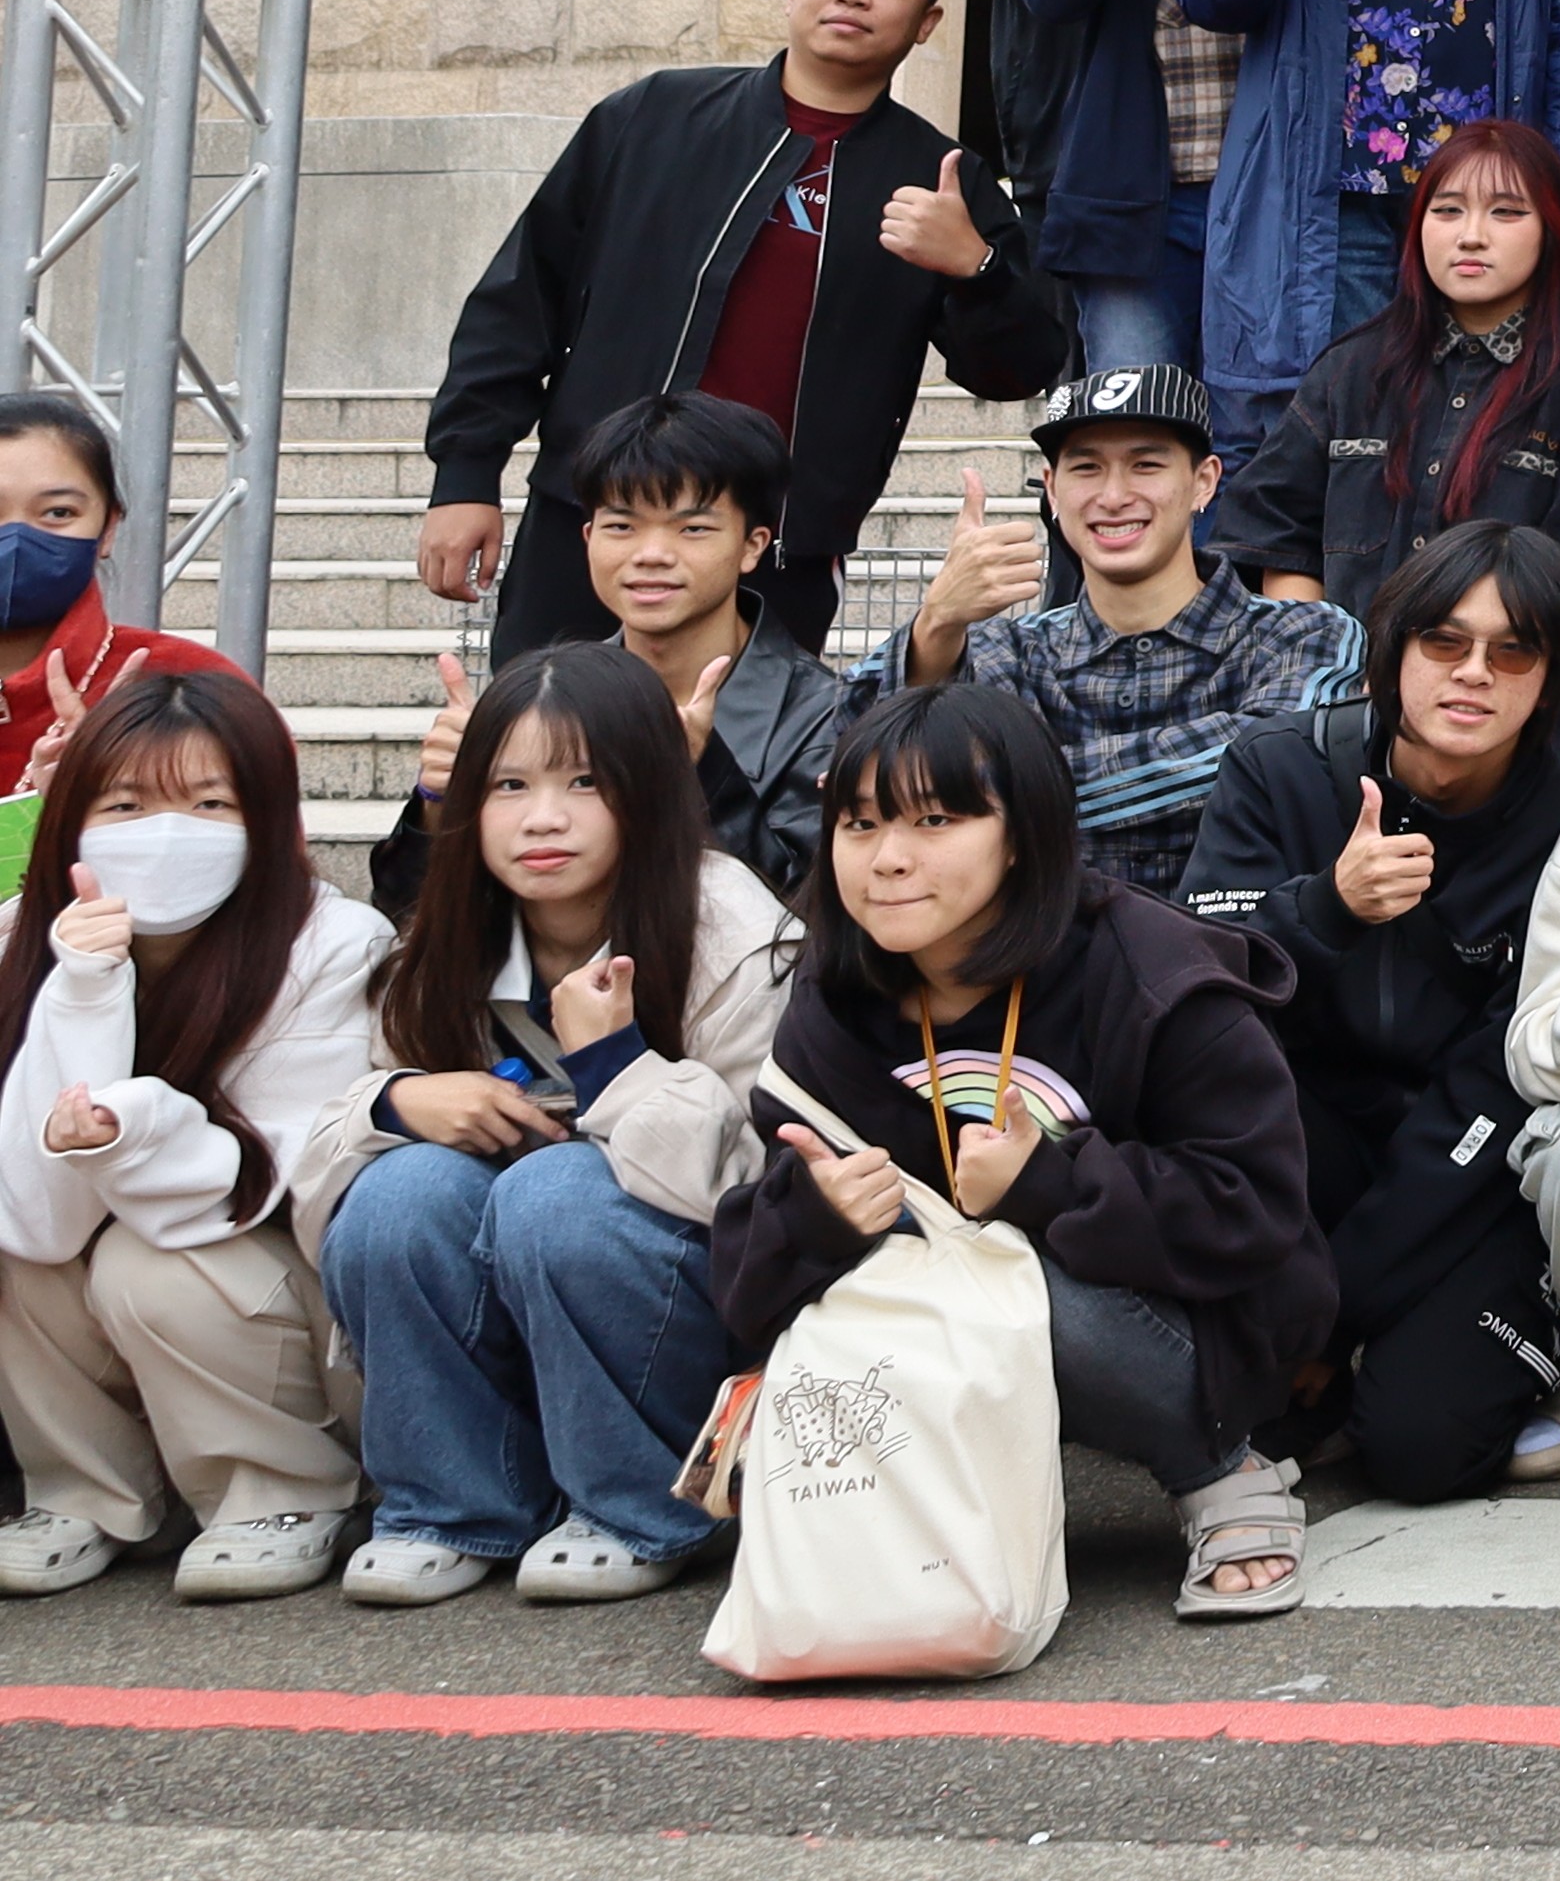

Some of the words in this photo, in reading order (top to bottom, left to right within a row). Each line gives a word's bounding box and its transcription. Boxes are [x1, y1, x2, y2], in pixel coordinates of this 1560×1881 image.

[796, 185, 827, 205] Kle
[1187, 893, 1196, 905] A
[1240, 902, 1257, 912] on
[788, 1474, 876, 1503] TAIWAN
